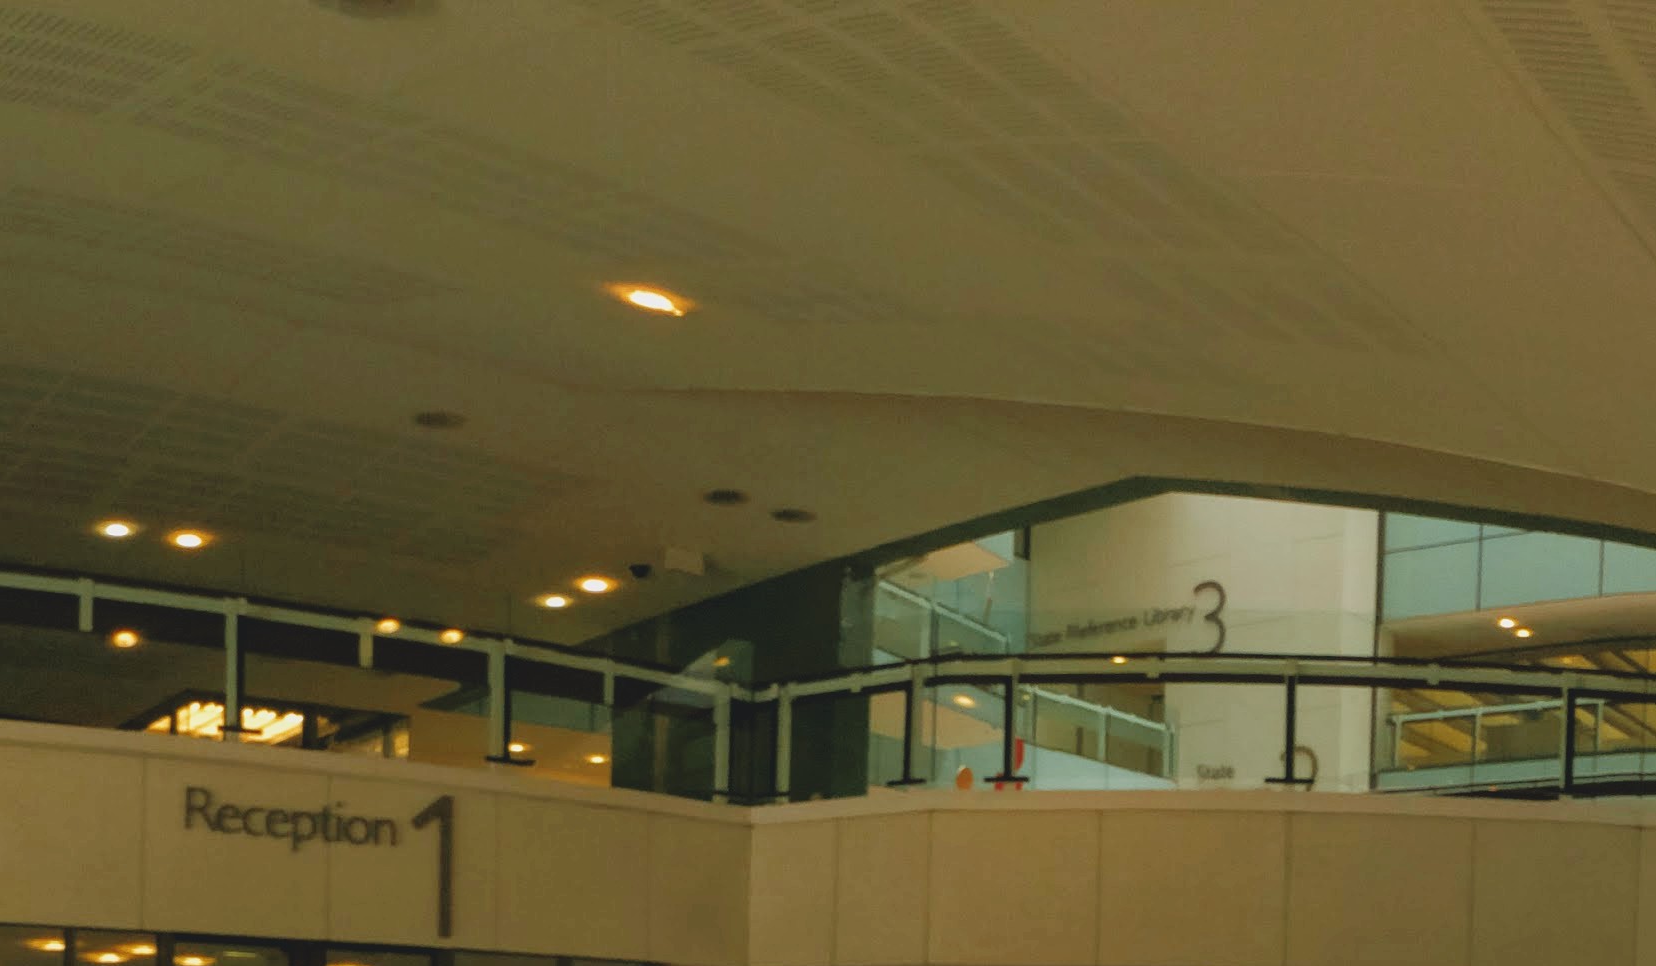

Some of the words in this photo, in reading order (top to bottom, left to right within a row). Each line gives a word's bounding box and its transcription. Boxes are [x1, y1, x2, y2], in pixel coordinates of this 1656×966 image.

[1065, 615, 1137, 640] Reference
[1143, 605, 1196, 627] Library
[183, 785, 398, 852] Reception
